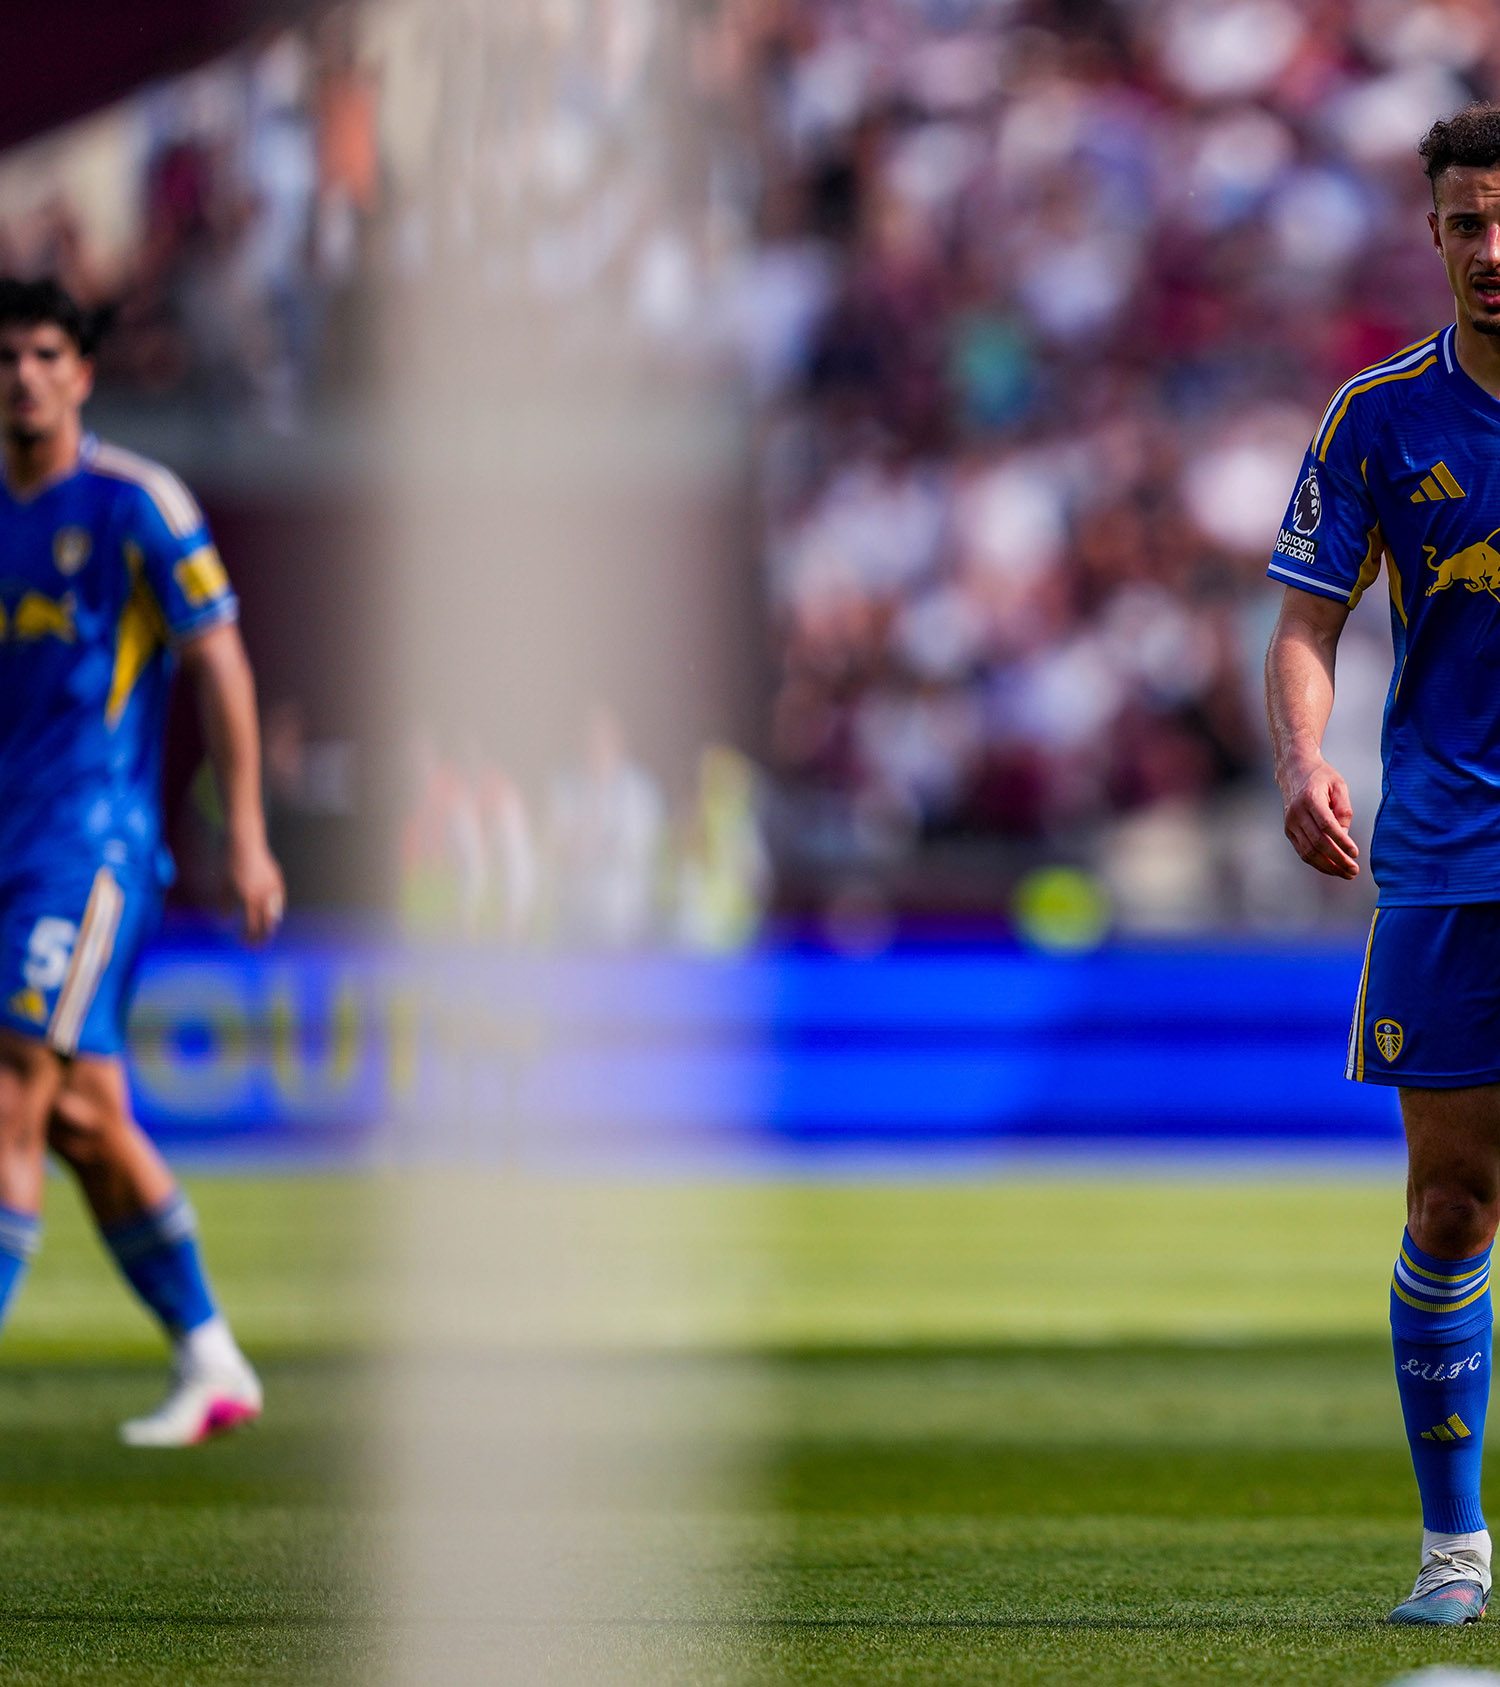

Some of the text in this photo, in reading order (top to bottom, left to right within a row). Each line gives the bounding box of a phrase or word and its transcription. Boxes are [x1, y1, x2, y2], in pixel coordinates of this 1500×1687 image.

[1275, 540, 1315, 564] for racism
[1278, 529, 1315, 552] No room
[23, 917, 78, 990] 5
[1401, 1352, 1482, 1381] LUFC
